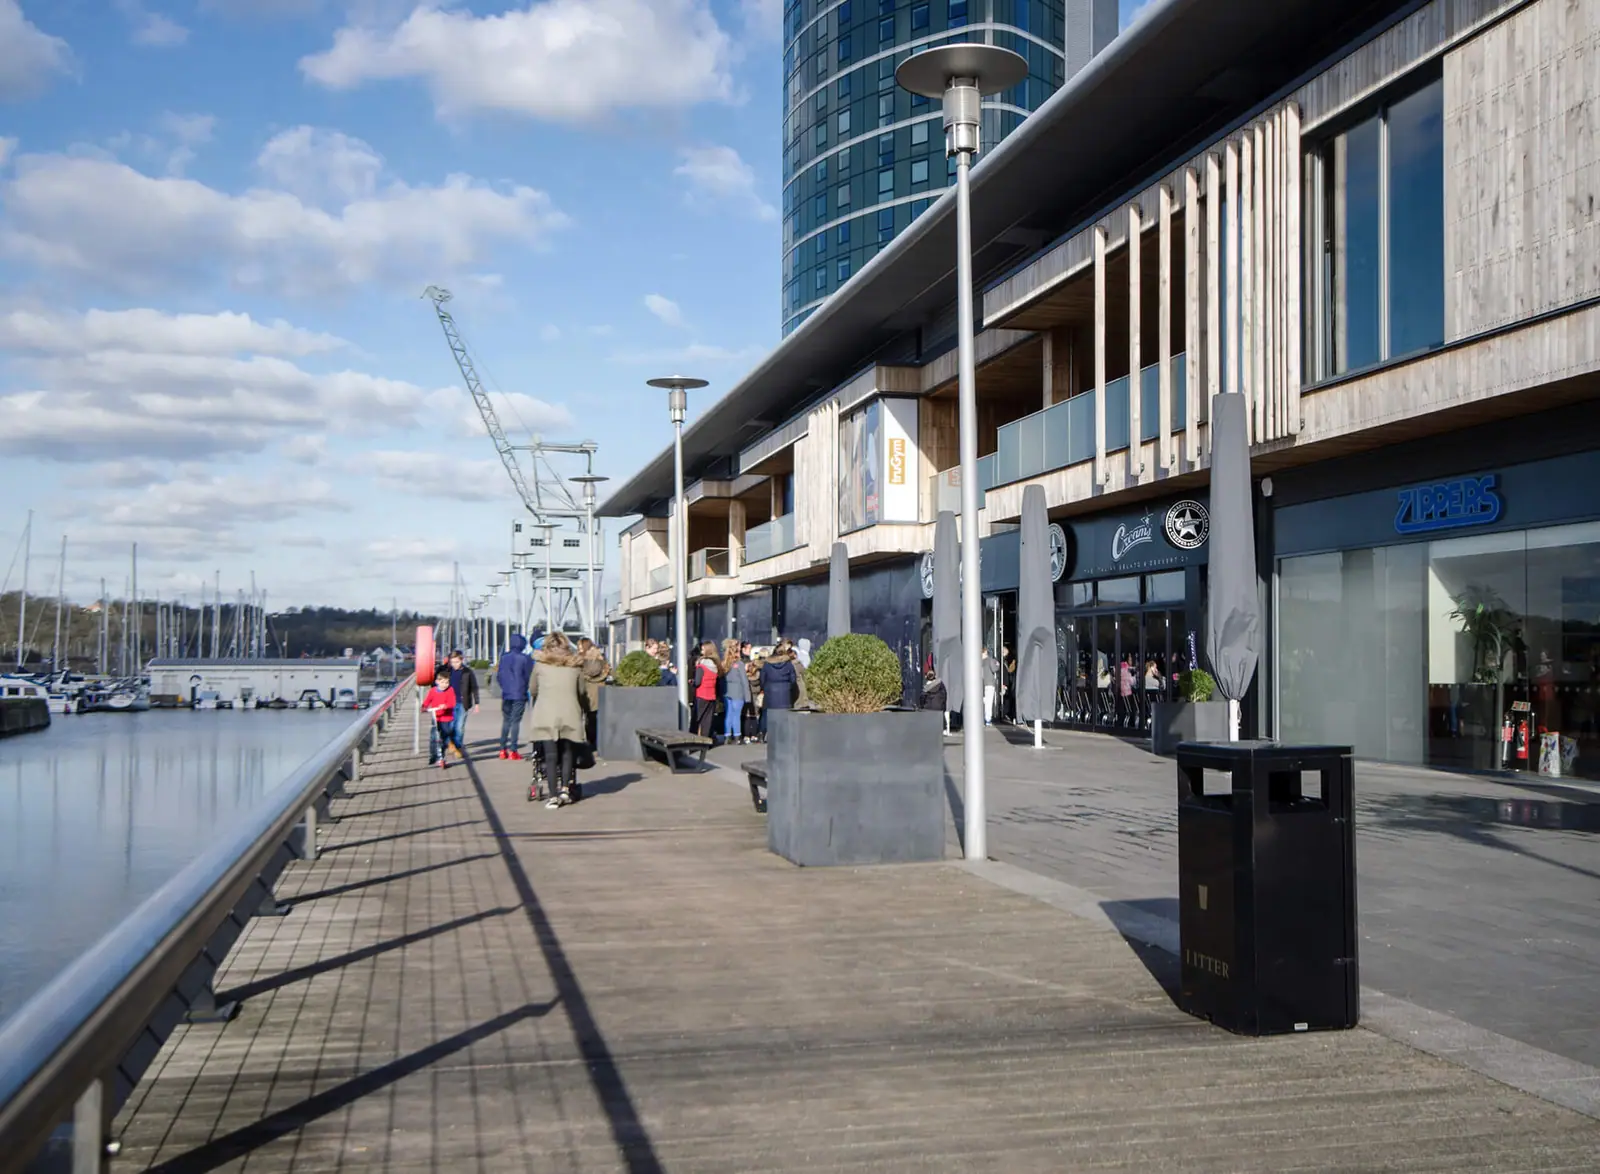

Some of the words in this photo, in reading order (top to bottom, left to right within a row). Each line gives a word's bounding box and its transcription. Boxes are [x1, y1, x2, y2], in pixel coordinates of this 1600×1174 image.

[889, 439, 905, 483] truGym
[1394, 474, 1502, 534] ZIPPERS
[1185, 948, 1230, 979] LITTER
